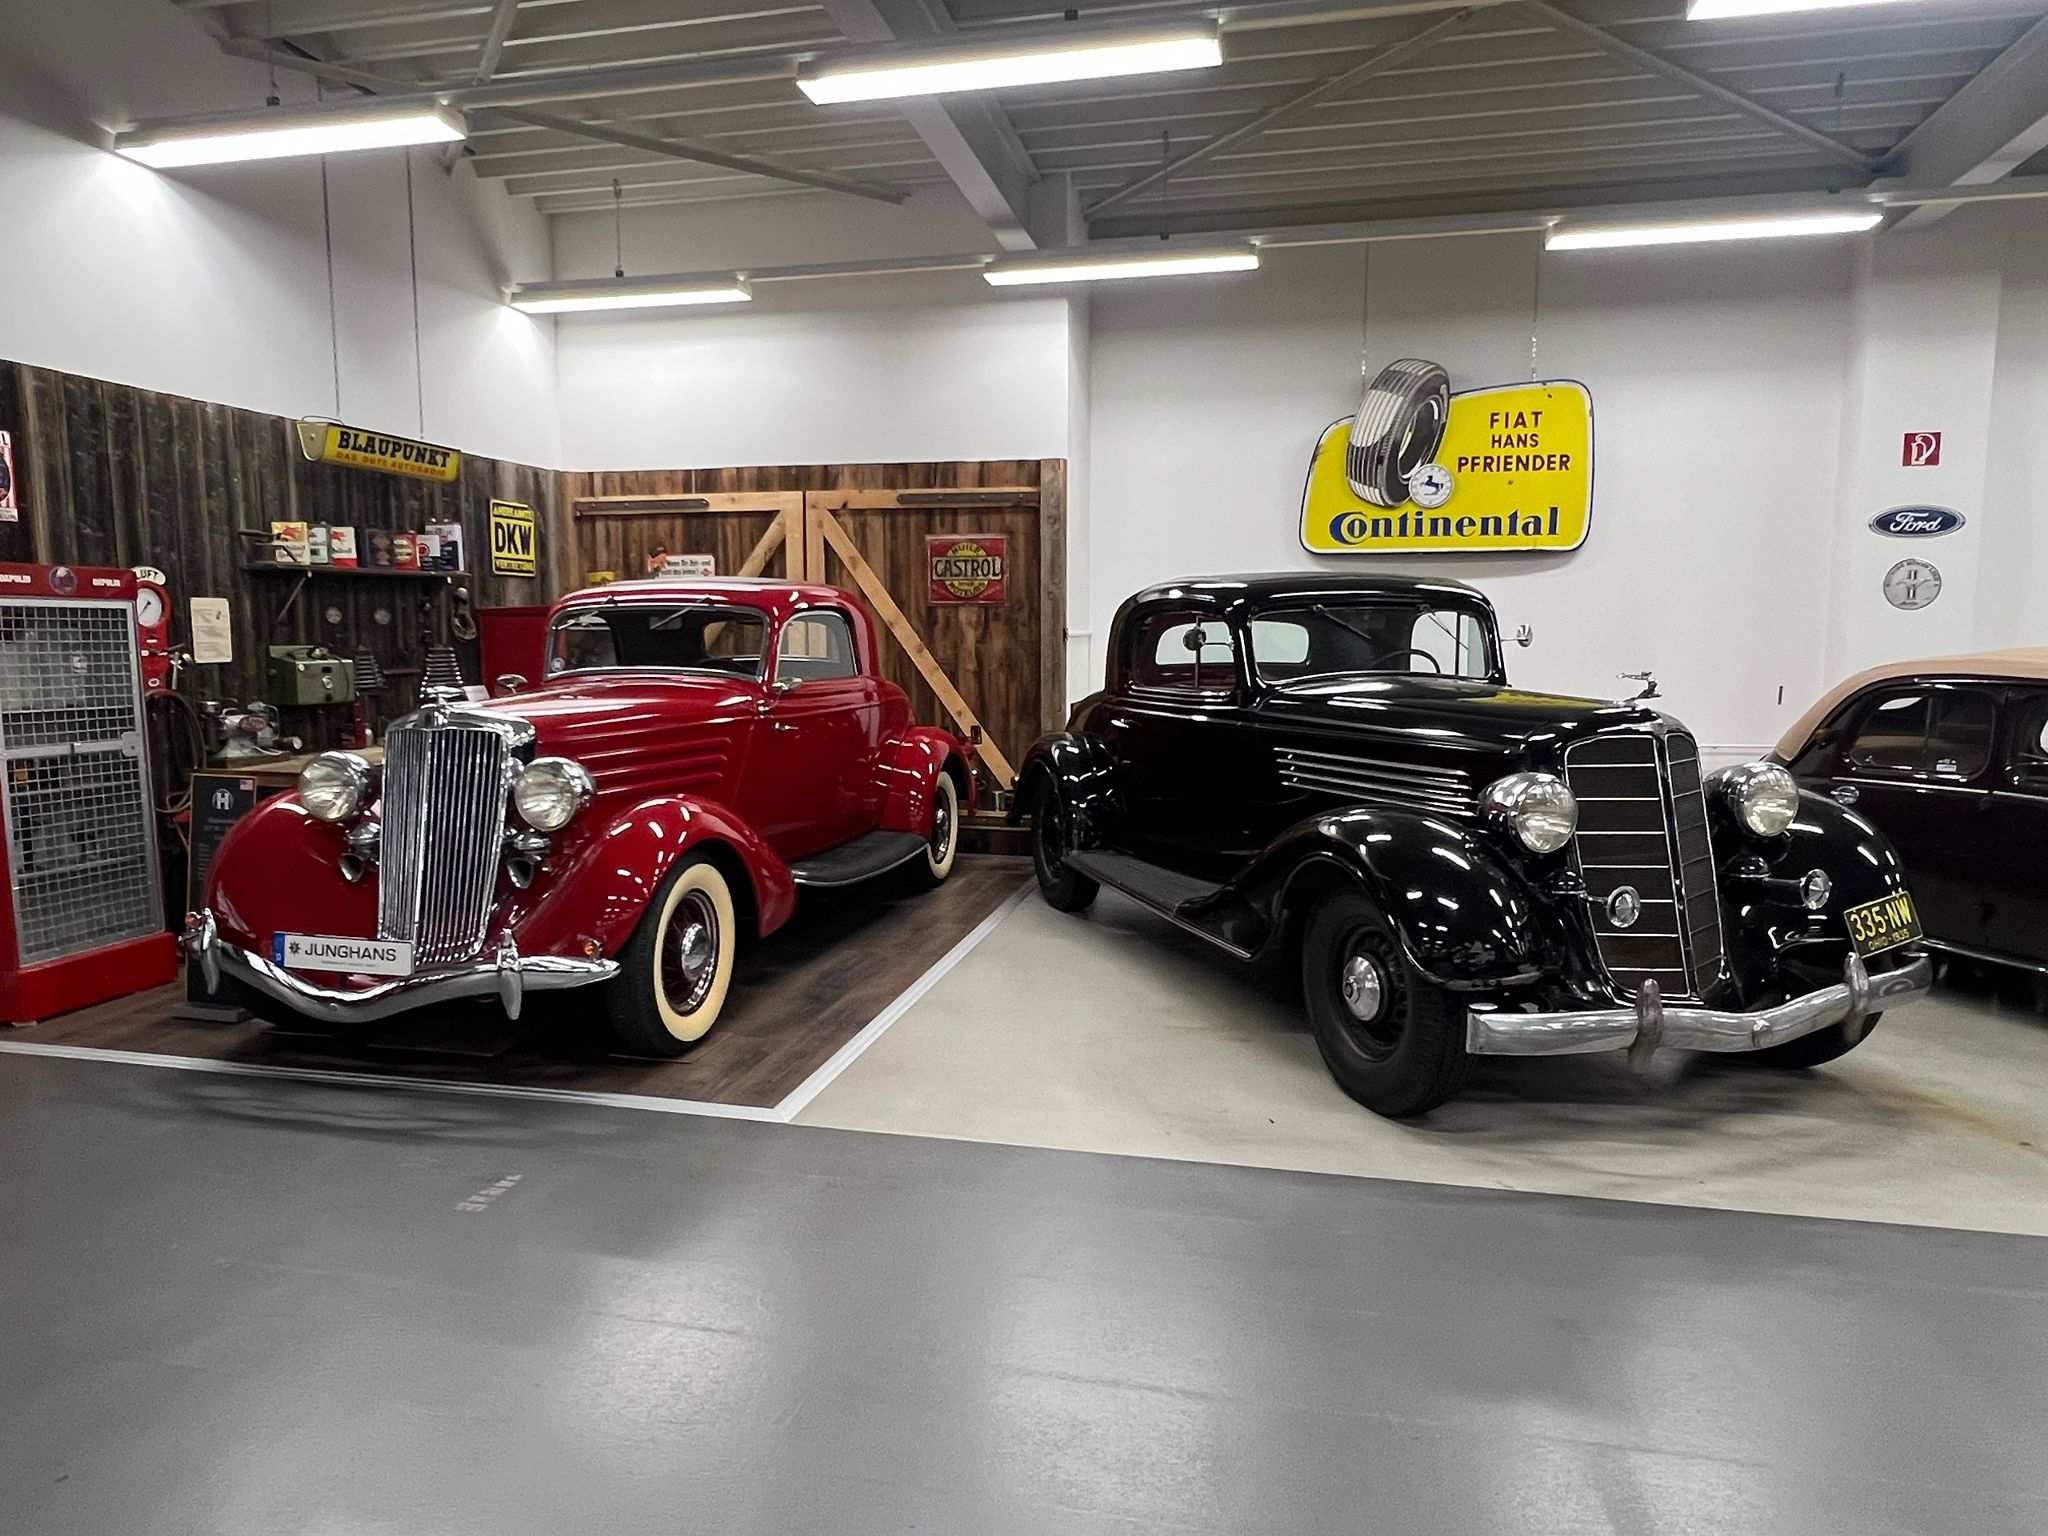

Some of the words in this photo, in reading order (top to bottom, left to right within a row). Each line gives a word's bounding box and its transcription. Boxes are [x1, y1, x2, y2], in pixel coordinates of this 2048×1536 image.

[1490, 411, 1543, 430] FIAT
[337, 430, 451, 468] BLAUPUNKT
[1491, 433, 1540, 449] HANS
[1457, 454, 1571, 473] PFRIENDER
[1329, 506, 1560, 545] Continental
[1889, 511, 1943, 532] Ford
[494, 521, 532, 556] DKW
[934, 558, 1002, 578] CASTROL
[304, 943, 397, 962] JUNGHANS
